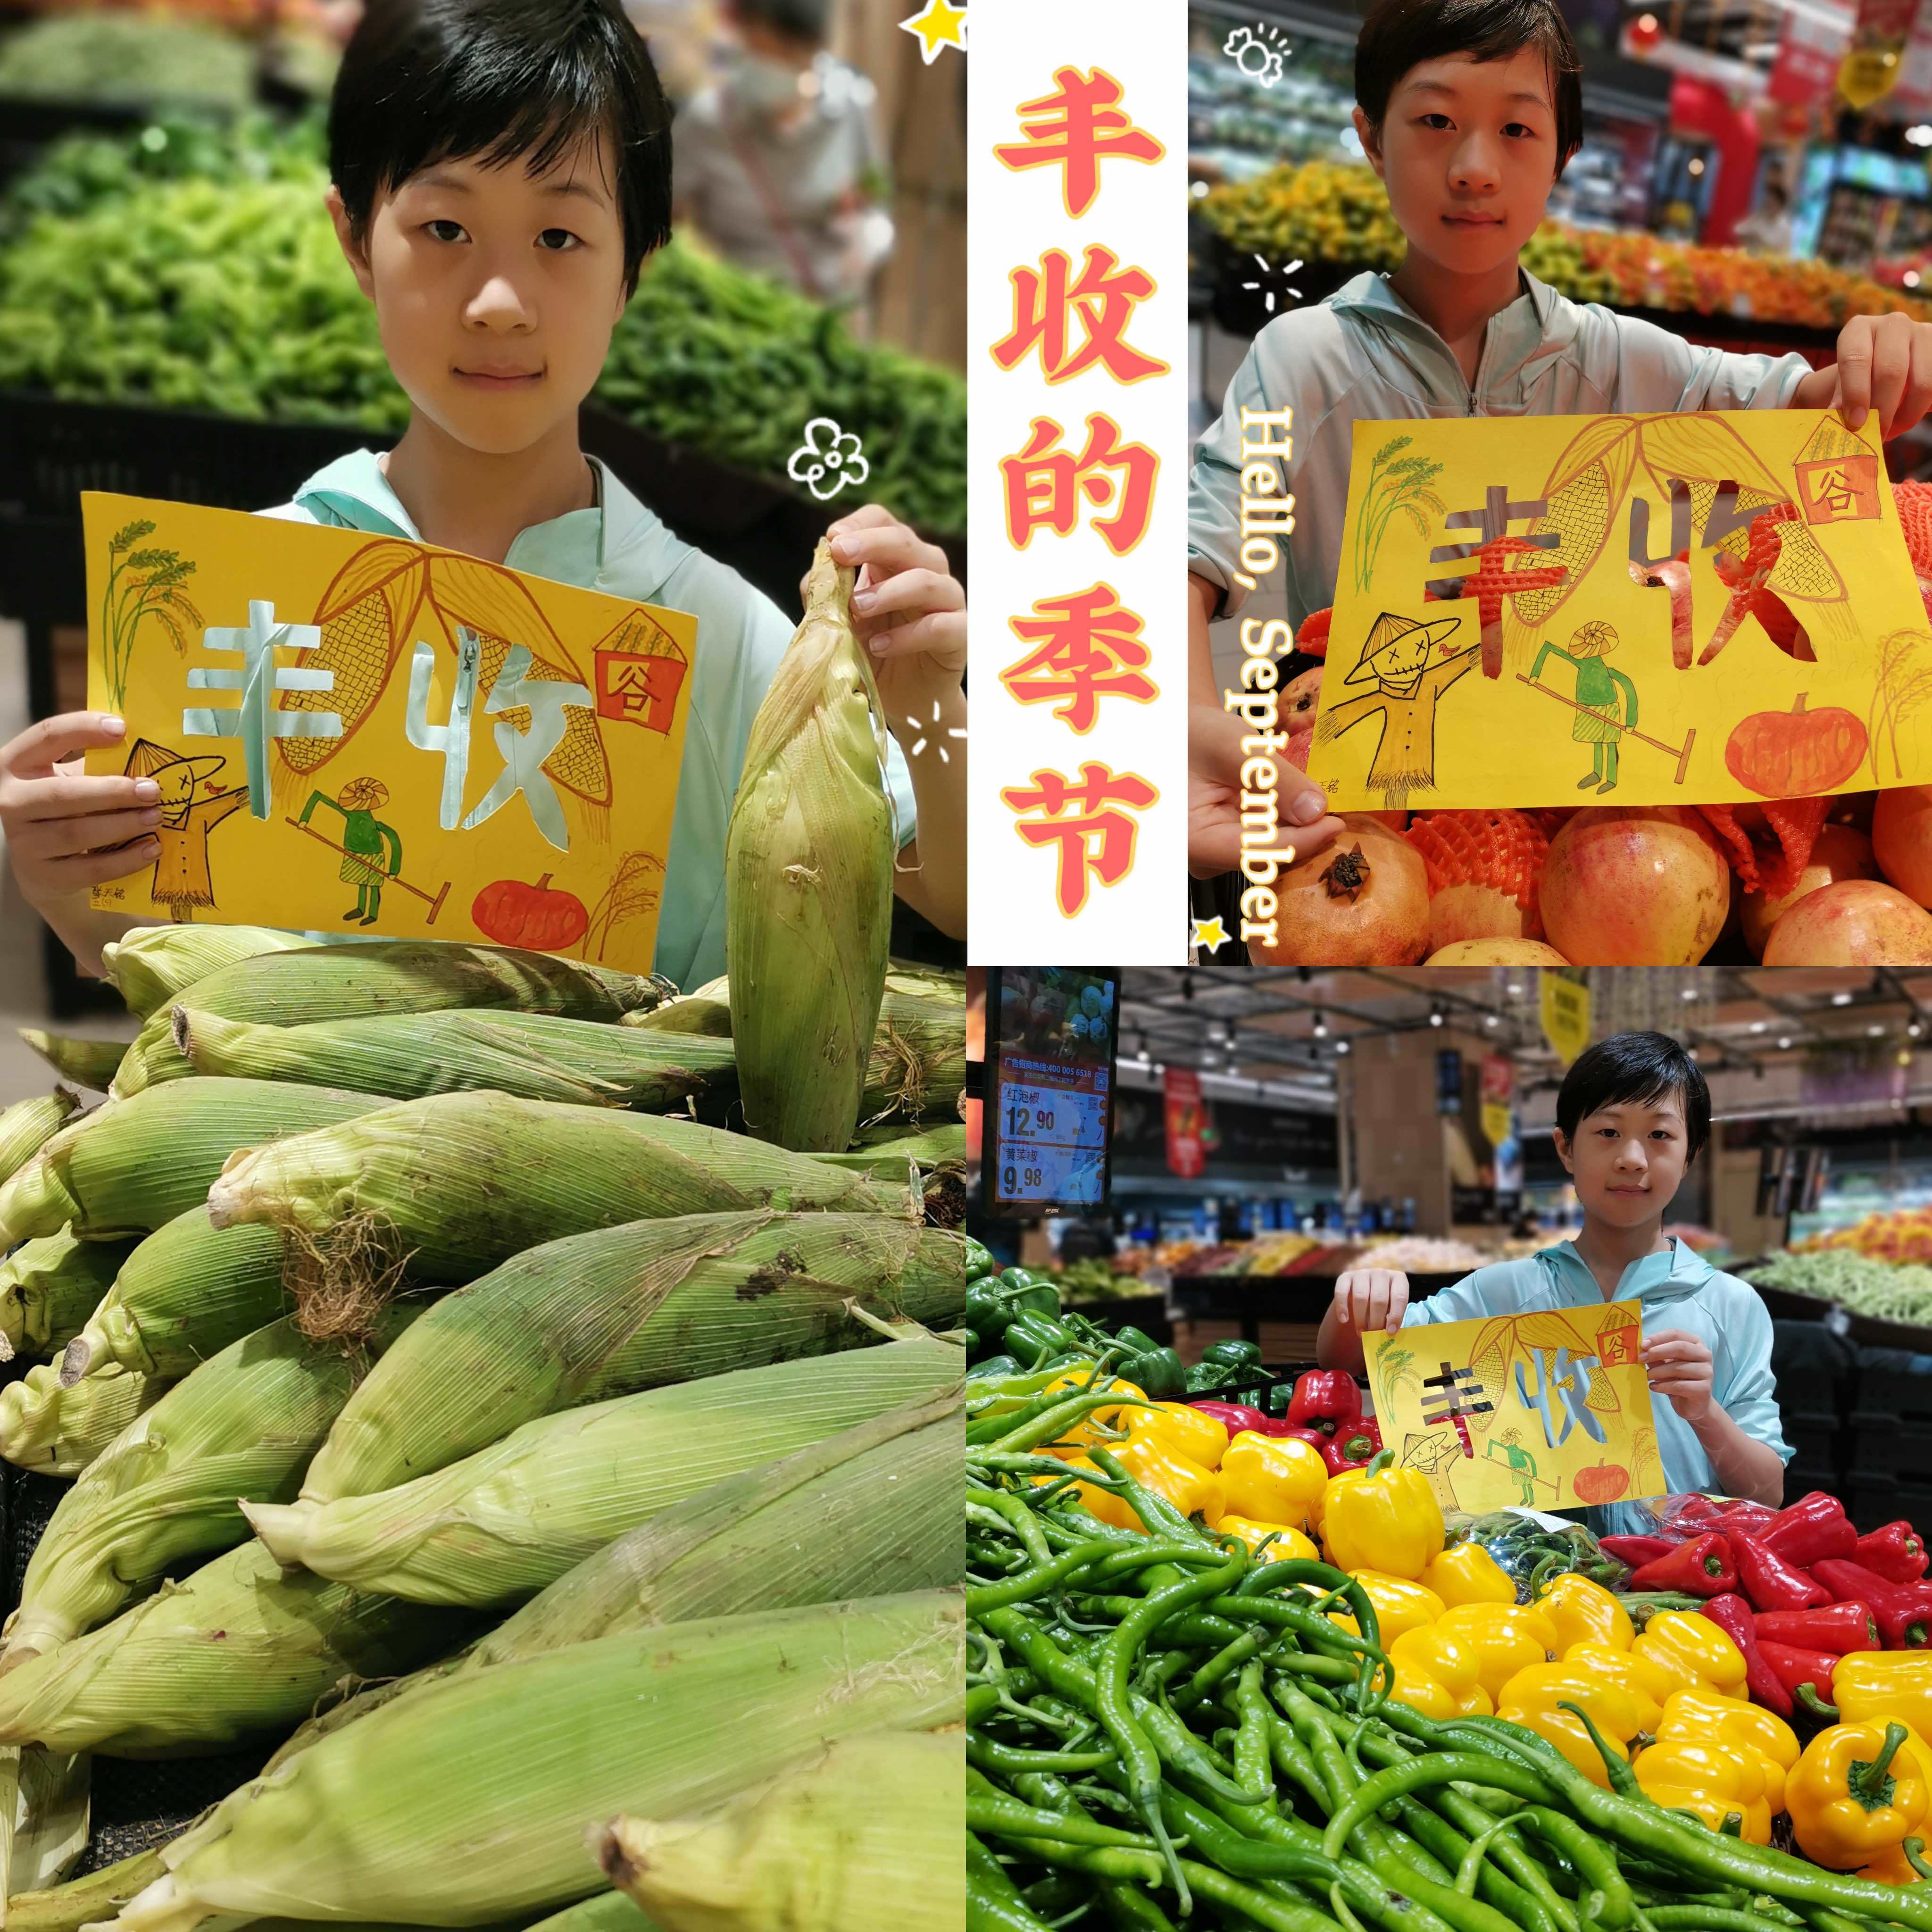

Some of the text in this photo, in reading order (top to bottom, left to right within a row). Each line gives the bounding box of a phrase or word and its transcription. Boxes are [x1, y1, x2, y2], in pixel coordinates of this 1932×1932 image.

[1813, 470, 1865, 510] 谷
[1424, 479, 1817, 680] 丰收
[608, 666, 660, 711] 谷
[183, 600, 592, 852] 丰收
[1062, 1066, 1074, 1075] 005
[1076, 1068, 1091, 1078] 6518
[1006, 1107, 1054, 1137] 12.90
[1004, 1166, 1042, 1194] 9.98
[1608, 1335, 1631, 1359] 谷
[1421, 1347, 1607, 1459] 丰收
